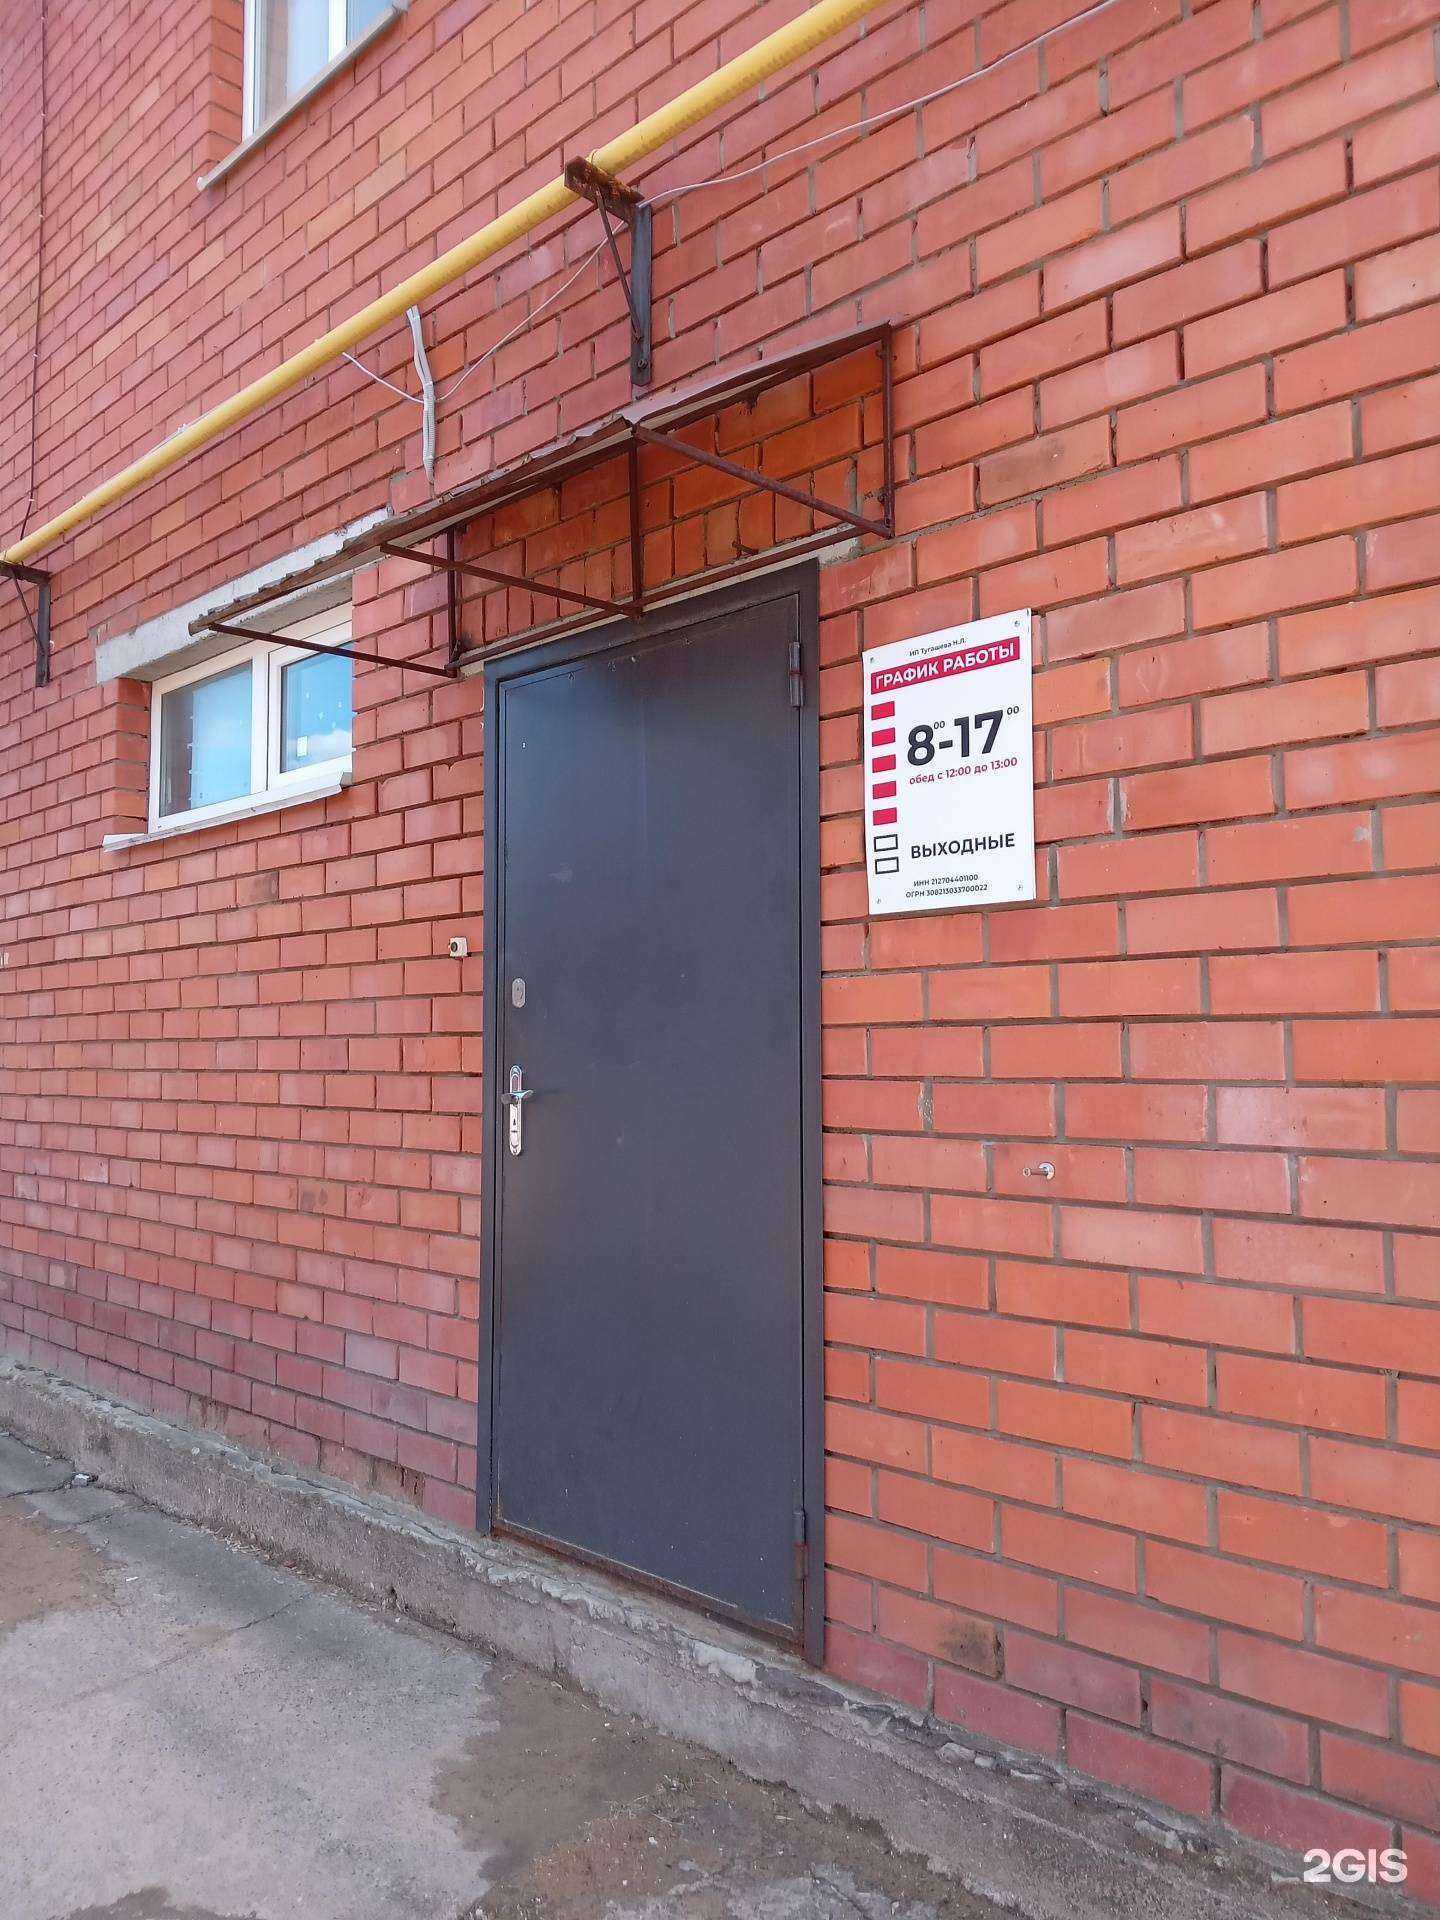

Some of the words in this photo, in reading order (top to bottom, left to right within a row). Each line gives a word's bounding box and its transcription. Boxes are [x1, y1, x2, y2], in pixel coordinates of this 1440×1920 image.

[875, 661, 939, 690] ГРАФИК
[943, 642, 1014, 672] РАБОТЫ
[909, 774, 934, 785] обед
[945, 766, 971, 778] 12:00
[974, 764, 988, 775] до
[990, 757, 1018, 770] 13:00
[911, 833, 1015, 859] ВЫХОДНЫЕ
[905, 890, 925, 898] ОГРН
